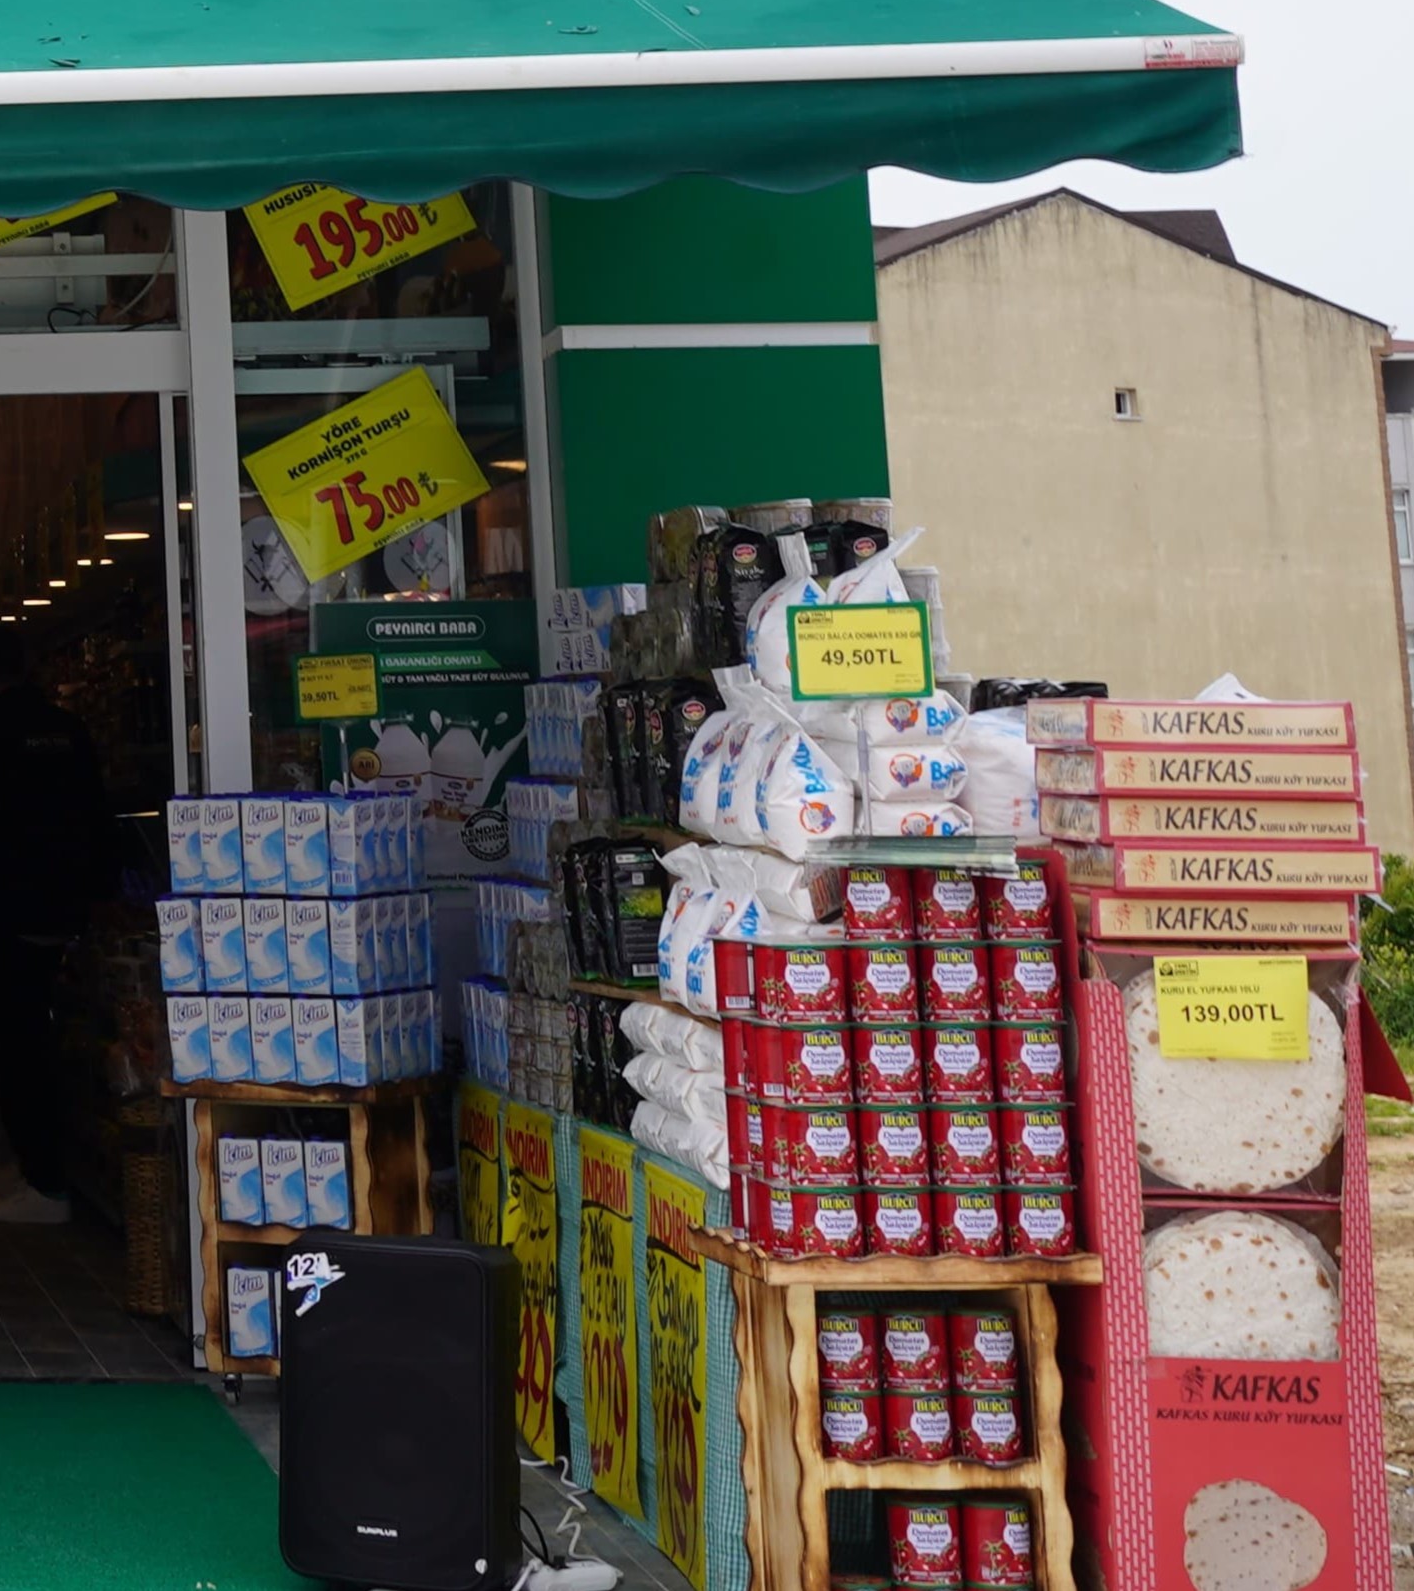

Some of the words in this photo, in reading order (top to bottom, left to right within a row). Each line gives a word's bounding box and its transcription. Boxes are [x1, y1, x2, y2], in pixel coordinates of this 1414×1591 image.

[293, 197, 419, 280] 195.00
[321, 416, 363, 444] YÖRE
[288, 437, 363, 481] KORNİŞON
[365, 408, 411, 440] TURŞU
[315, 470, 421, 545] 75.00
[375, 621, 436, 636] PEYNİRCİ
[439, 620, 477, 635] BABA
[821, 648, 902, 667] 49,50TL
[1151, 710, 1245, 735] KAFKAS
[1247, 727, 1273, 737] KURU
[1275, 726, 1295, 737] KÖY
[1297, 725, 1340, 737] YUFKASI
[1159, 758, 1253, 783] KAFKAS
[1254, 775, 1280, 786] KURU
[1283, 774, 1303, 786] KÖY
[1305, 774, 1347, 786] YUFKASI
[1164, 806, 1258, 831] KAFKAS
[848, 867, 886, 883] BURCU
[1180, 857, 1274, 882] KAFKAS
[1155, 906, 1249, 931] KAFKAS
[787, 950, 824, 964] BURCU
[1160, 986, 1185, 995] KURU
[1187, 986, 1198, 994] EL
[1201, 985, 1238, 994] YUFKASI
[1181, 1004, 1284, 1025] 139,00TL
[937, 1032, 975, 1046] BURCU
[581, 1143, 627, 1213] İNDİRİM
[879, 1195, 917, 1210] BURCU
[820, 1319, 858, 1333] BURCU
[1212, 1373, 1321, 1405] KAFKAS
[1156, 1408, 1209, 1422] KAFKAS
[1212, 1409, 1250, 1423] KURU
[1254, 1408, 1279, 1424] KÖY
[1286, 1411, 1343, 1426] YUFKASI
[910, 1511, 948, 1524] BURCU
